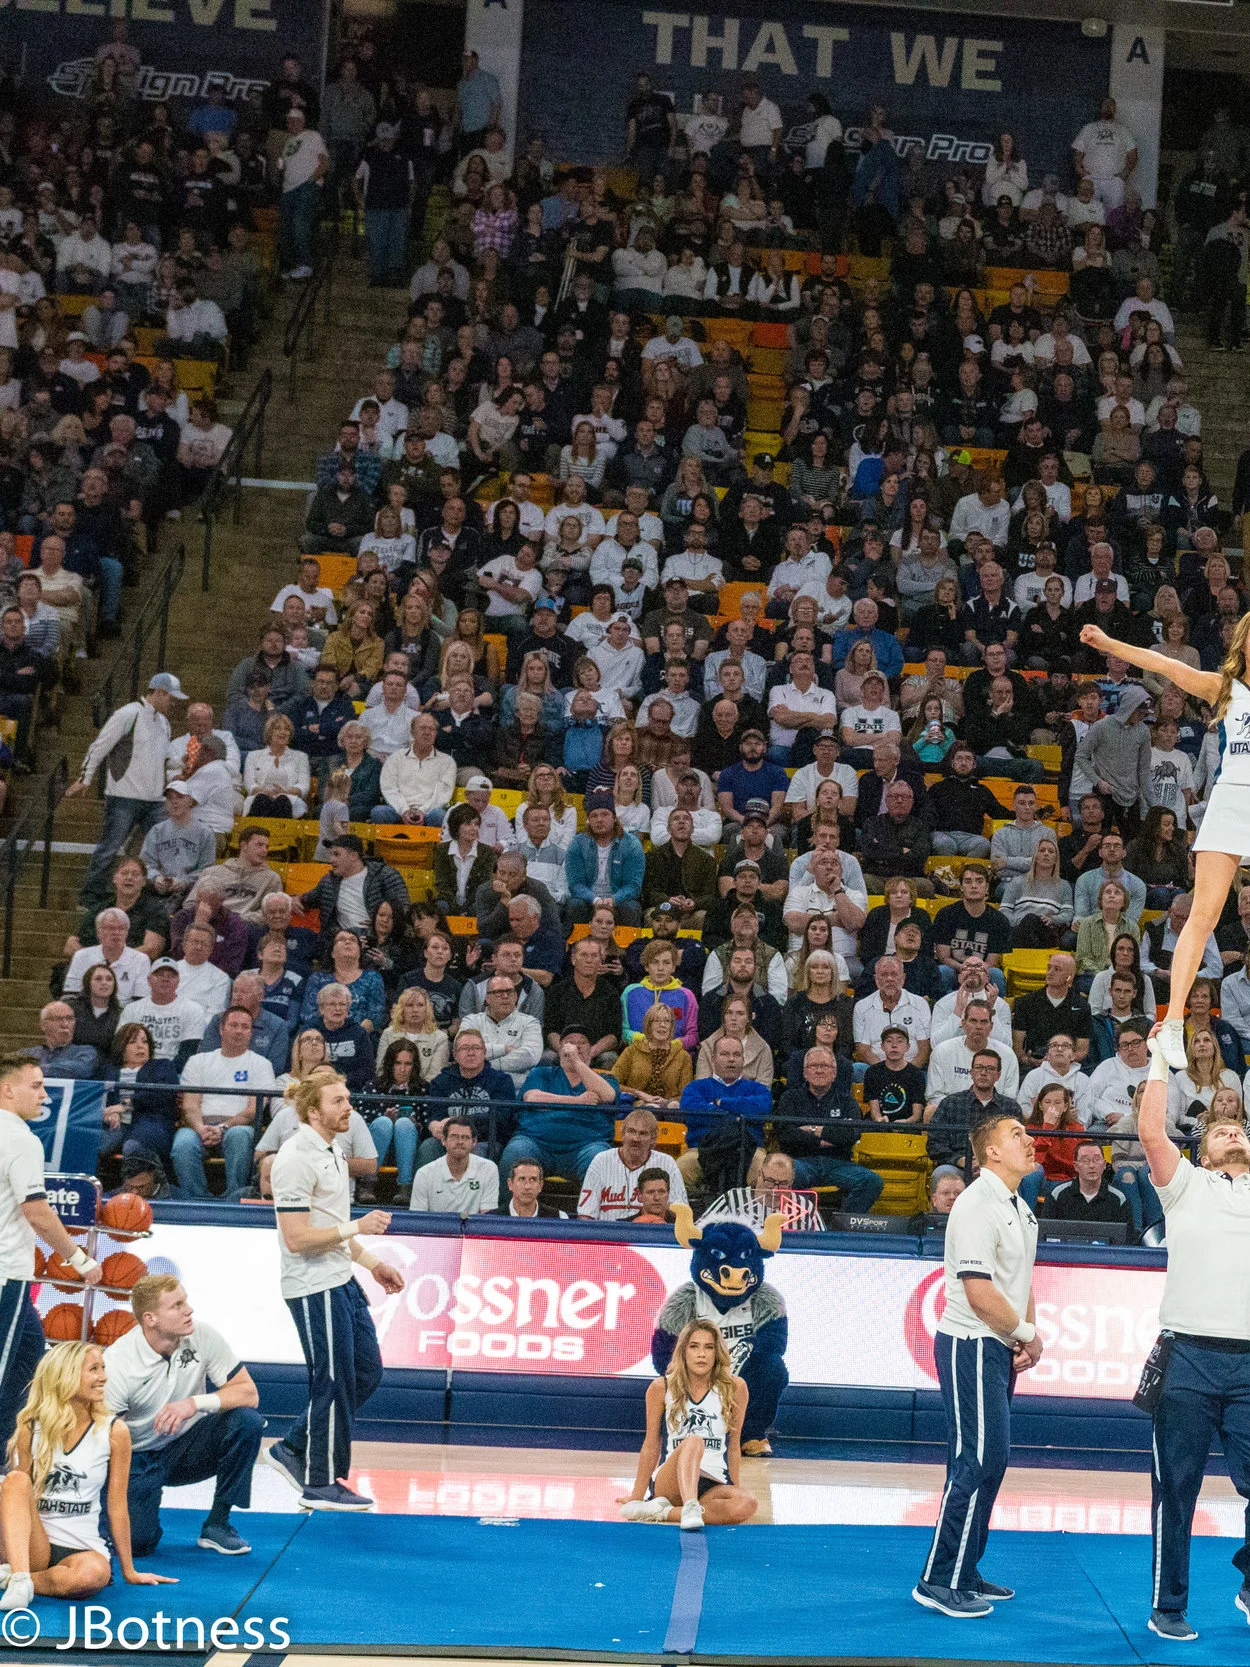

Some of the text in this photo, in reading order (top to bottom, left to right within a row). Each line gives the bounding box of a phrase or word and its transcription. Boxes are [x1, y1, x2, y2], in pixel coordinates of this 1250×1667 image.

[642, 11, 1003, 92] THAT WE
[1126, 36, 1150, 65] A
[926, 132, 995, 164] Pro
[1017, 552, 1036, 569] US
[950, 937, 988, 954] STATE
[46, 1188, 80, 1204] ate
[579, 1189, 593, 1208] 7
[601, 1185, 627, 1203] Mud
[721, 1323, 754, 1340] GIES
[418, 1329, 584, 1361] FOODS
[1028, 1357, 1141, 1385] OOD
[705, 1437, 723, 1451] ATE
[36, 1499, 92, 1515] TAH STATE
